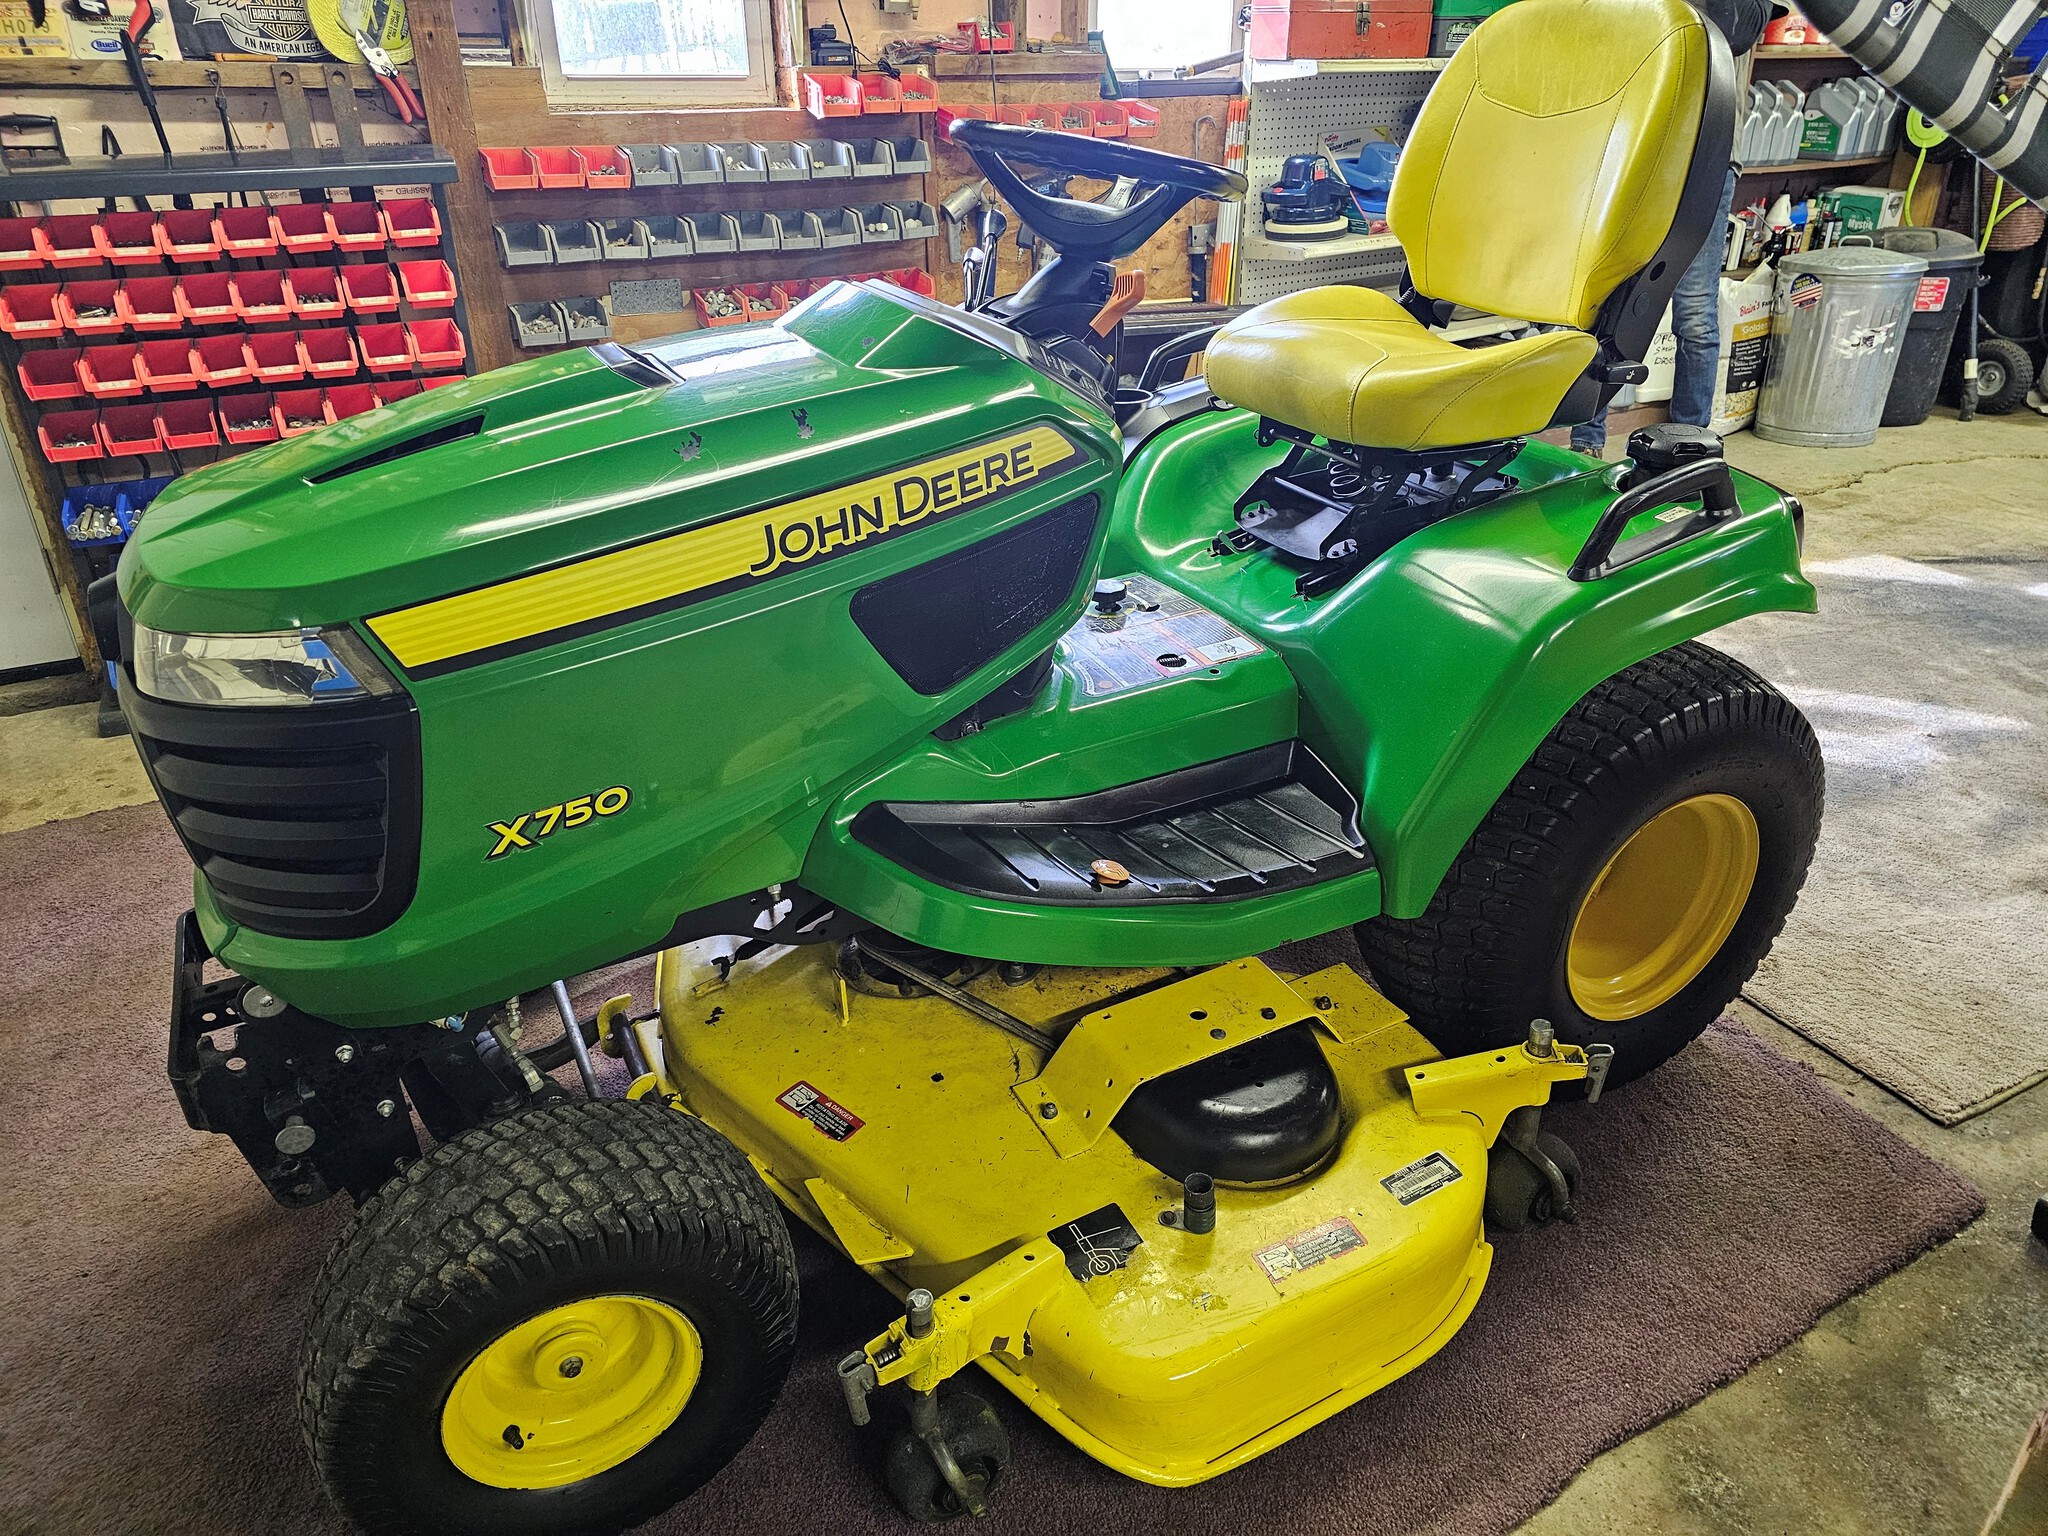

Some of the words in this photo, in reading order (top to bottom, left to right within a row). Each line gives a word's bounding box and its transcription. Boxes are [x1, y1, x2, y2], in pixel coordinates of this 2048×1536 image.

[252, 8, 307, 21] HARLEY-DAVIDSO
[268, 24, 300, 38] CLOTHES
[245, 37, 257, 49] AN
[260, 39, 300, 54] AMERICAN
[302, 42, 325, 54] LEGEN
[1848, 218, 1873, 230] Mystik
[749, 496, 885, 573] JOHN
[486, 785, 632, 860] X750
[815, 1102, 836, 1119] ROTATING
[833, 1116, 849, 1128] BLADE
[831, 1104, 854, 1121] DANGER
[1306, 1222, 1334, 1239] DANGER
